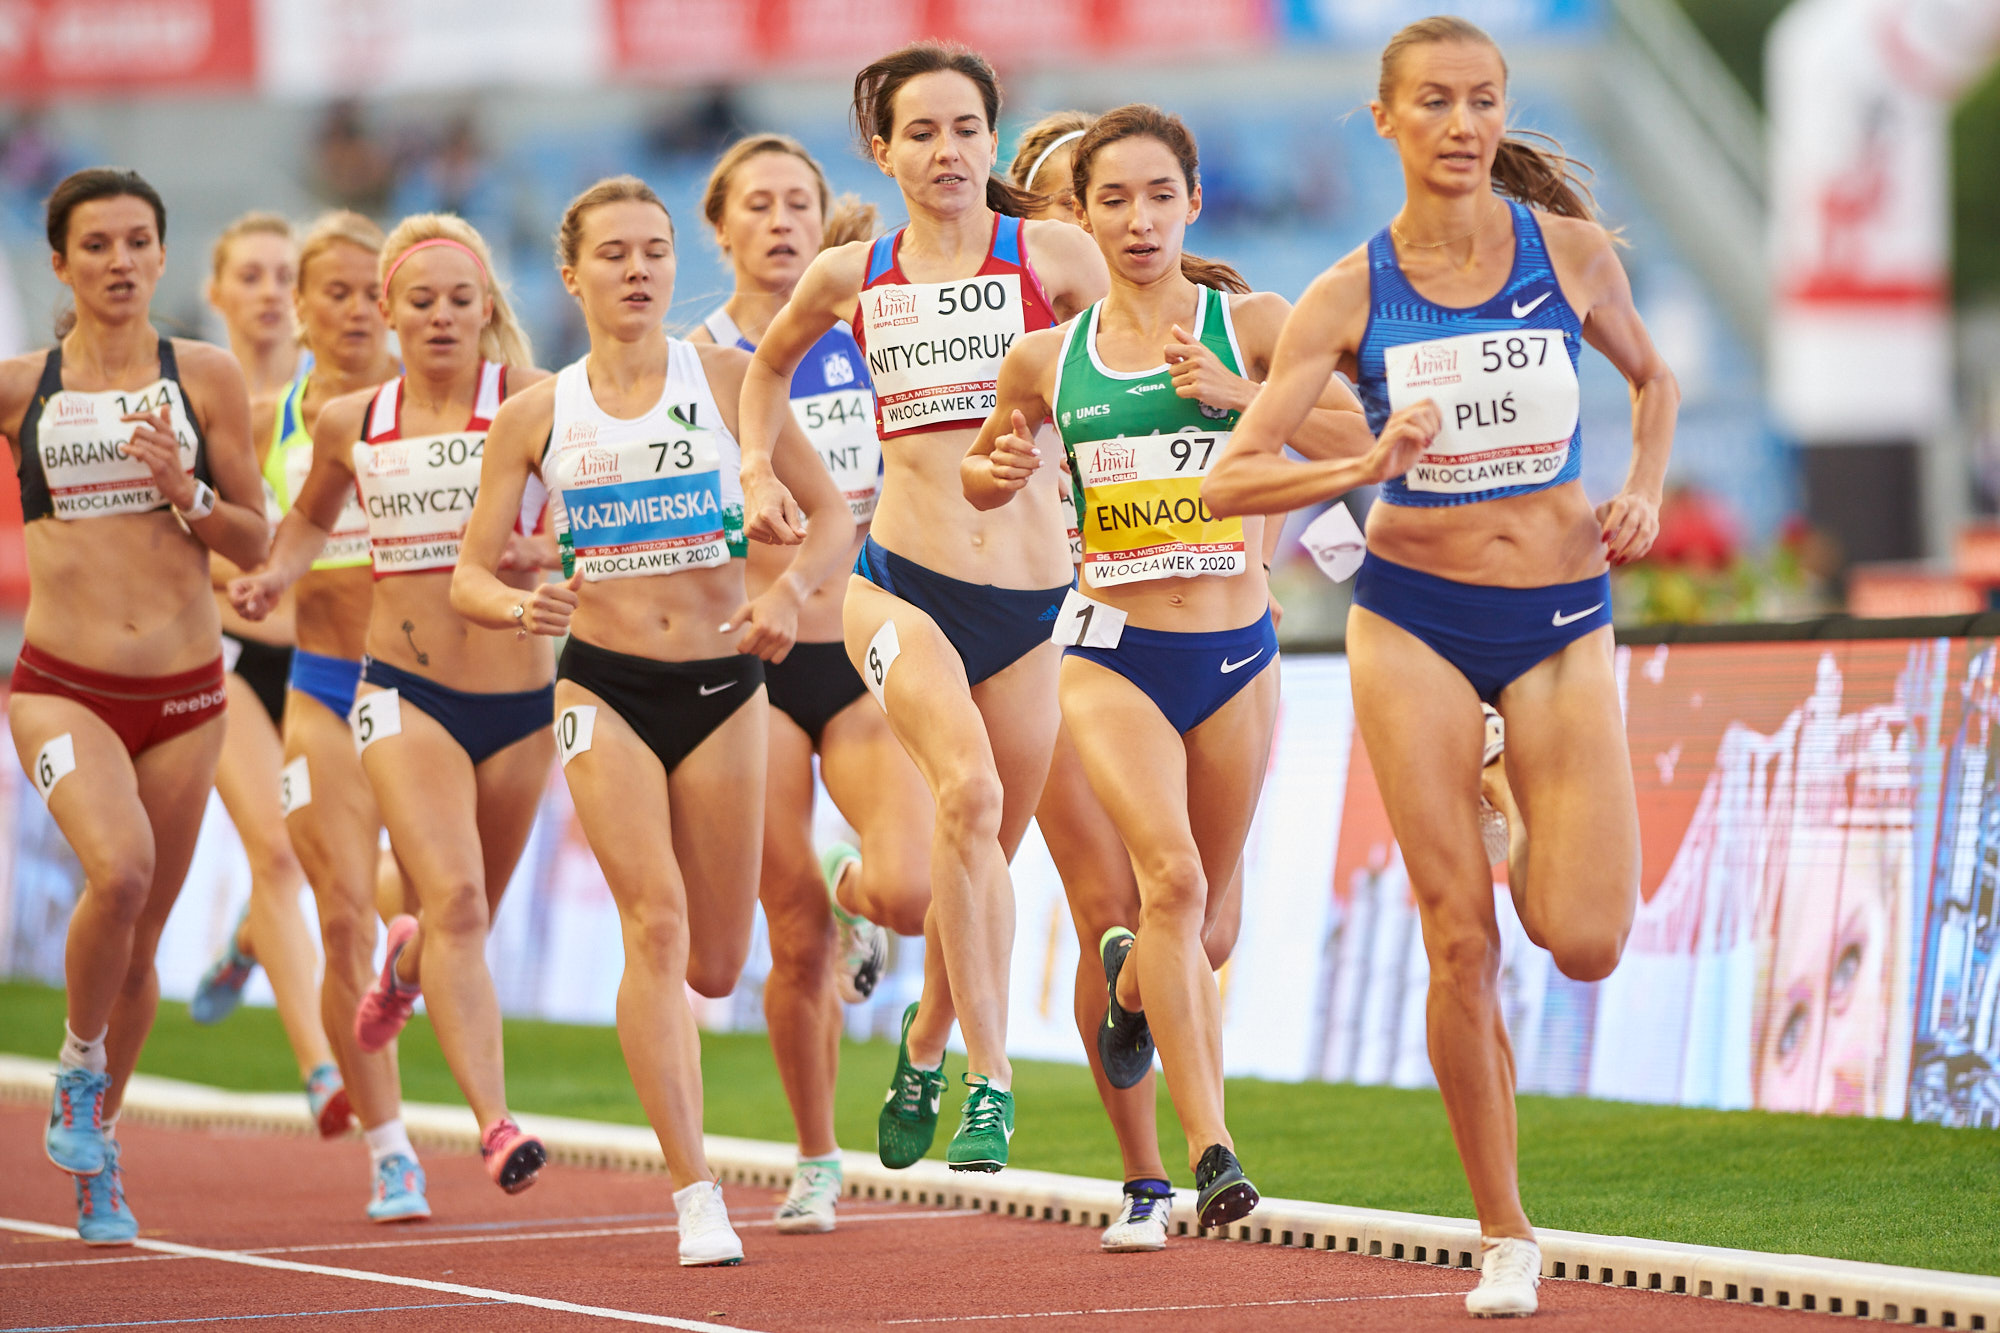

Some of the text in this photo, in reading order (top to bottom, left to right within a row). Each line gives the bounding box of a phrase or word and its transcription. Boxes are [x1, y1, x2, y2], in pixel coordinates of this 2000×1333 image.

[873, 280, 1006, 320] Anwil 500
[869, 332, 1015, 376] NITYCHORUK
[1406, 337, 1548, 377] Anwil 587
[888, 394, 997, 422] WŁOCŁAWEK 20
[896, 391, 914, 402] PZLA
[914, 383, 981, 398] MISTRZOSTWA
[806, 397, 866, 429] 544
[1076, 404, 1111, 420] UMCS
[1456, 392, 1517, 430] PLIŚ
[574, 440, 694, 477] Anwil 73
[1089, 438, 1215, 474] Anwil 97
[1416, 455, 1562, 483] WŁOCŁAWEK 202
[1113, 472, 1137, 482] ORLEN
[57, 490, 154, 512] WŁOCŁAWEK
[368, 487, 479, 518] CHRYCZY
[570, 489, 718, 531] KAZIMIERSKA
[1097, 498, 1222, 532] ENNAOU
[380, 543, 459, 562] WŁOCŁAWE
[585, 545, 720, 573] WŁOCŁAWEK 2020
[599, 547, 619, 555] PZLA
[621, 540, 686, 553] MISTRZOSTWA
[1113, 550, 1135, 559] PZLA
[1200, 543, 1233, 552] POLSKI
[1095, 556, 1236, 578] WŁOCŁAWEK 2020
[1075, 605, 1094, 646] 1
[869, 646, 883, 686] 8
[358, 703, 374, 742] 5
[40, 753, 54, 787] 6
